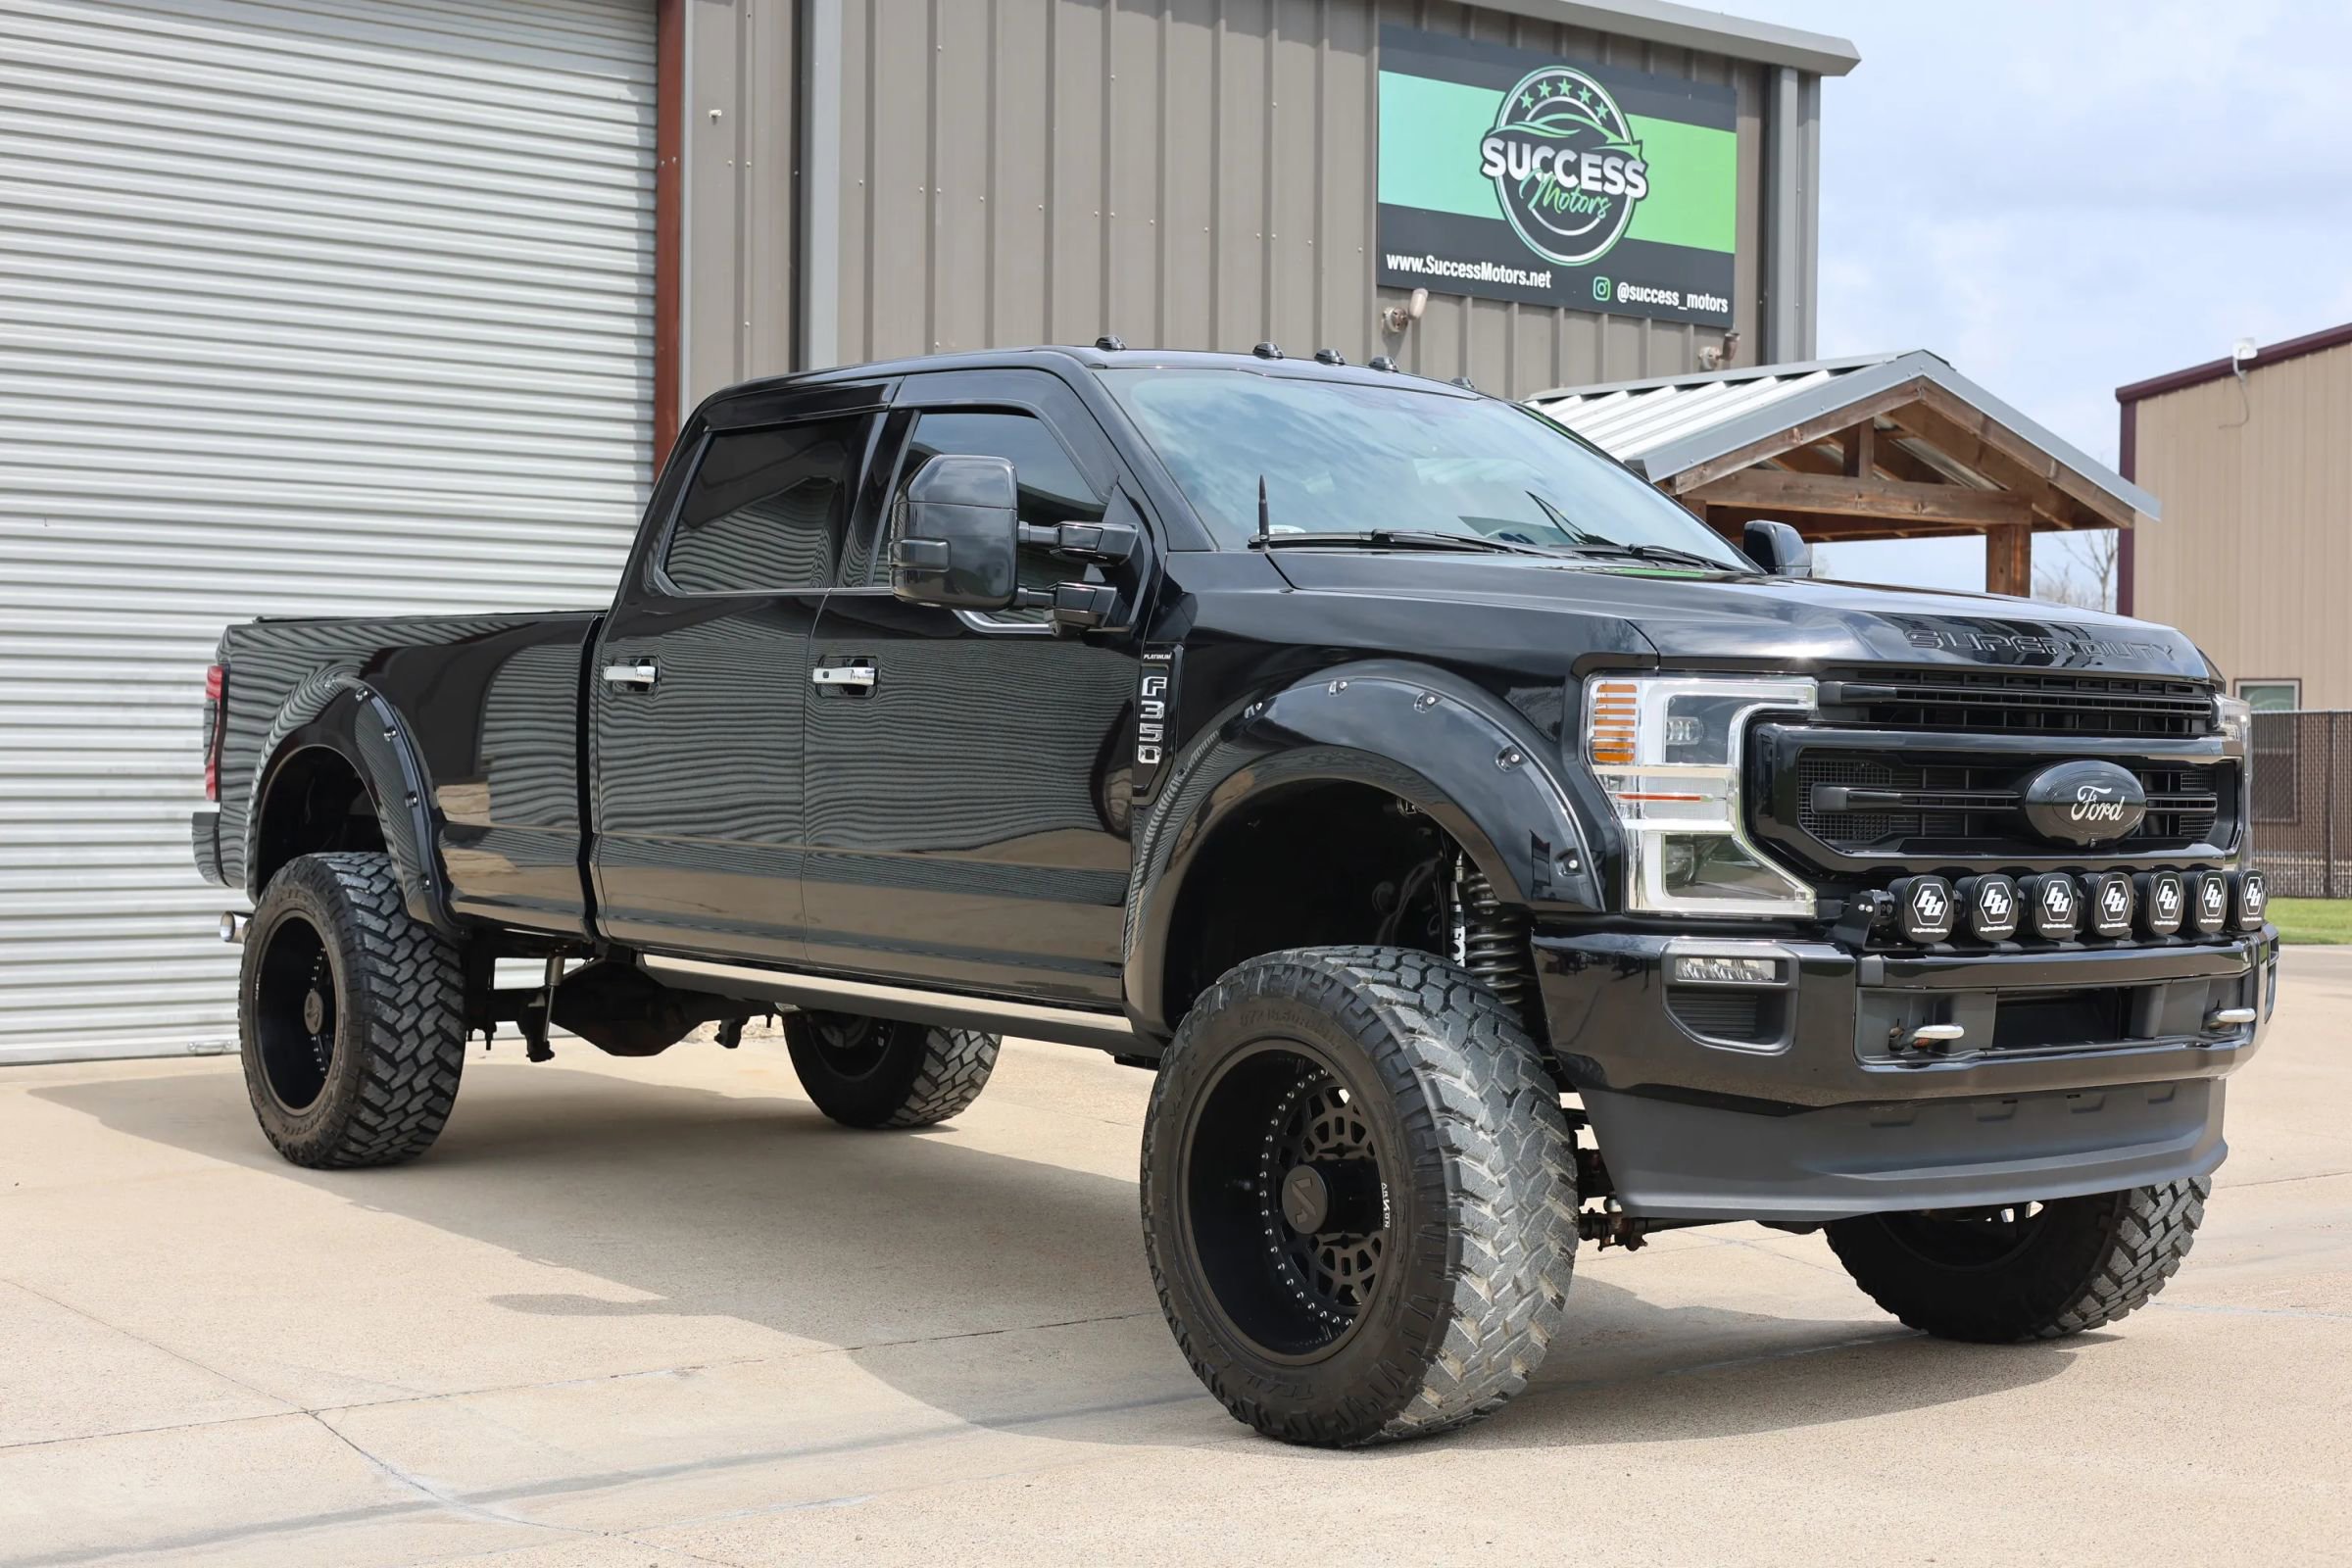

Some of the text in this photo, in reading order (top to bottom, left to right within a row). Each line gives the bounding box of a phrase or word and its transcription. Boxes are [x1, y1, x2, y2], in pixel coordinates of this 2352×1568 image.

[1482, 137, 1648, 199] SUCCESS
[1519, 168, 1612, 220] Motors
[1386, 253, 1551, 289] www.SuccessMotors.net
[1616, 281, 1729, 314] @success_motors
[1906, 630, 2176, 662] SUPER DUTY
[1138, 675, 1167, 763] F350
[2071, 785, 2124, 822] Ford
